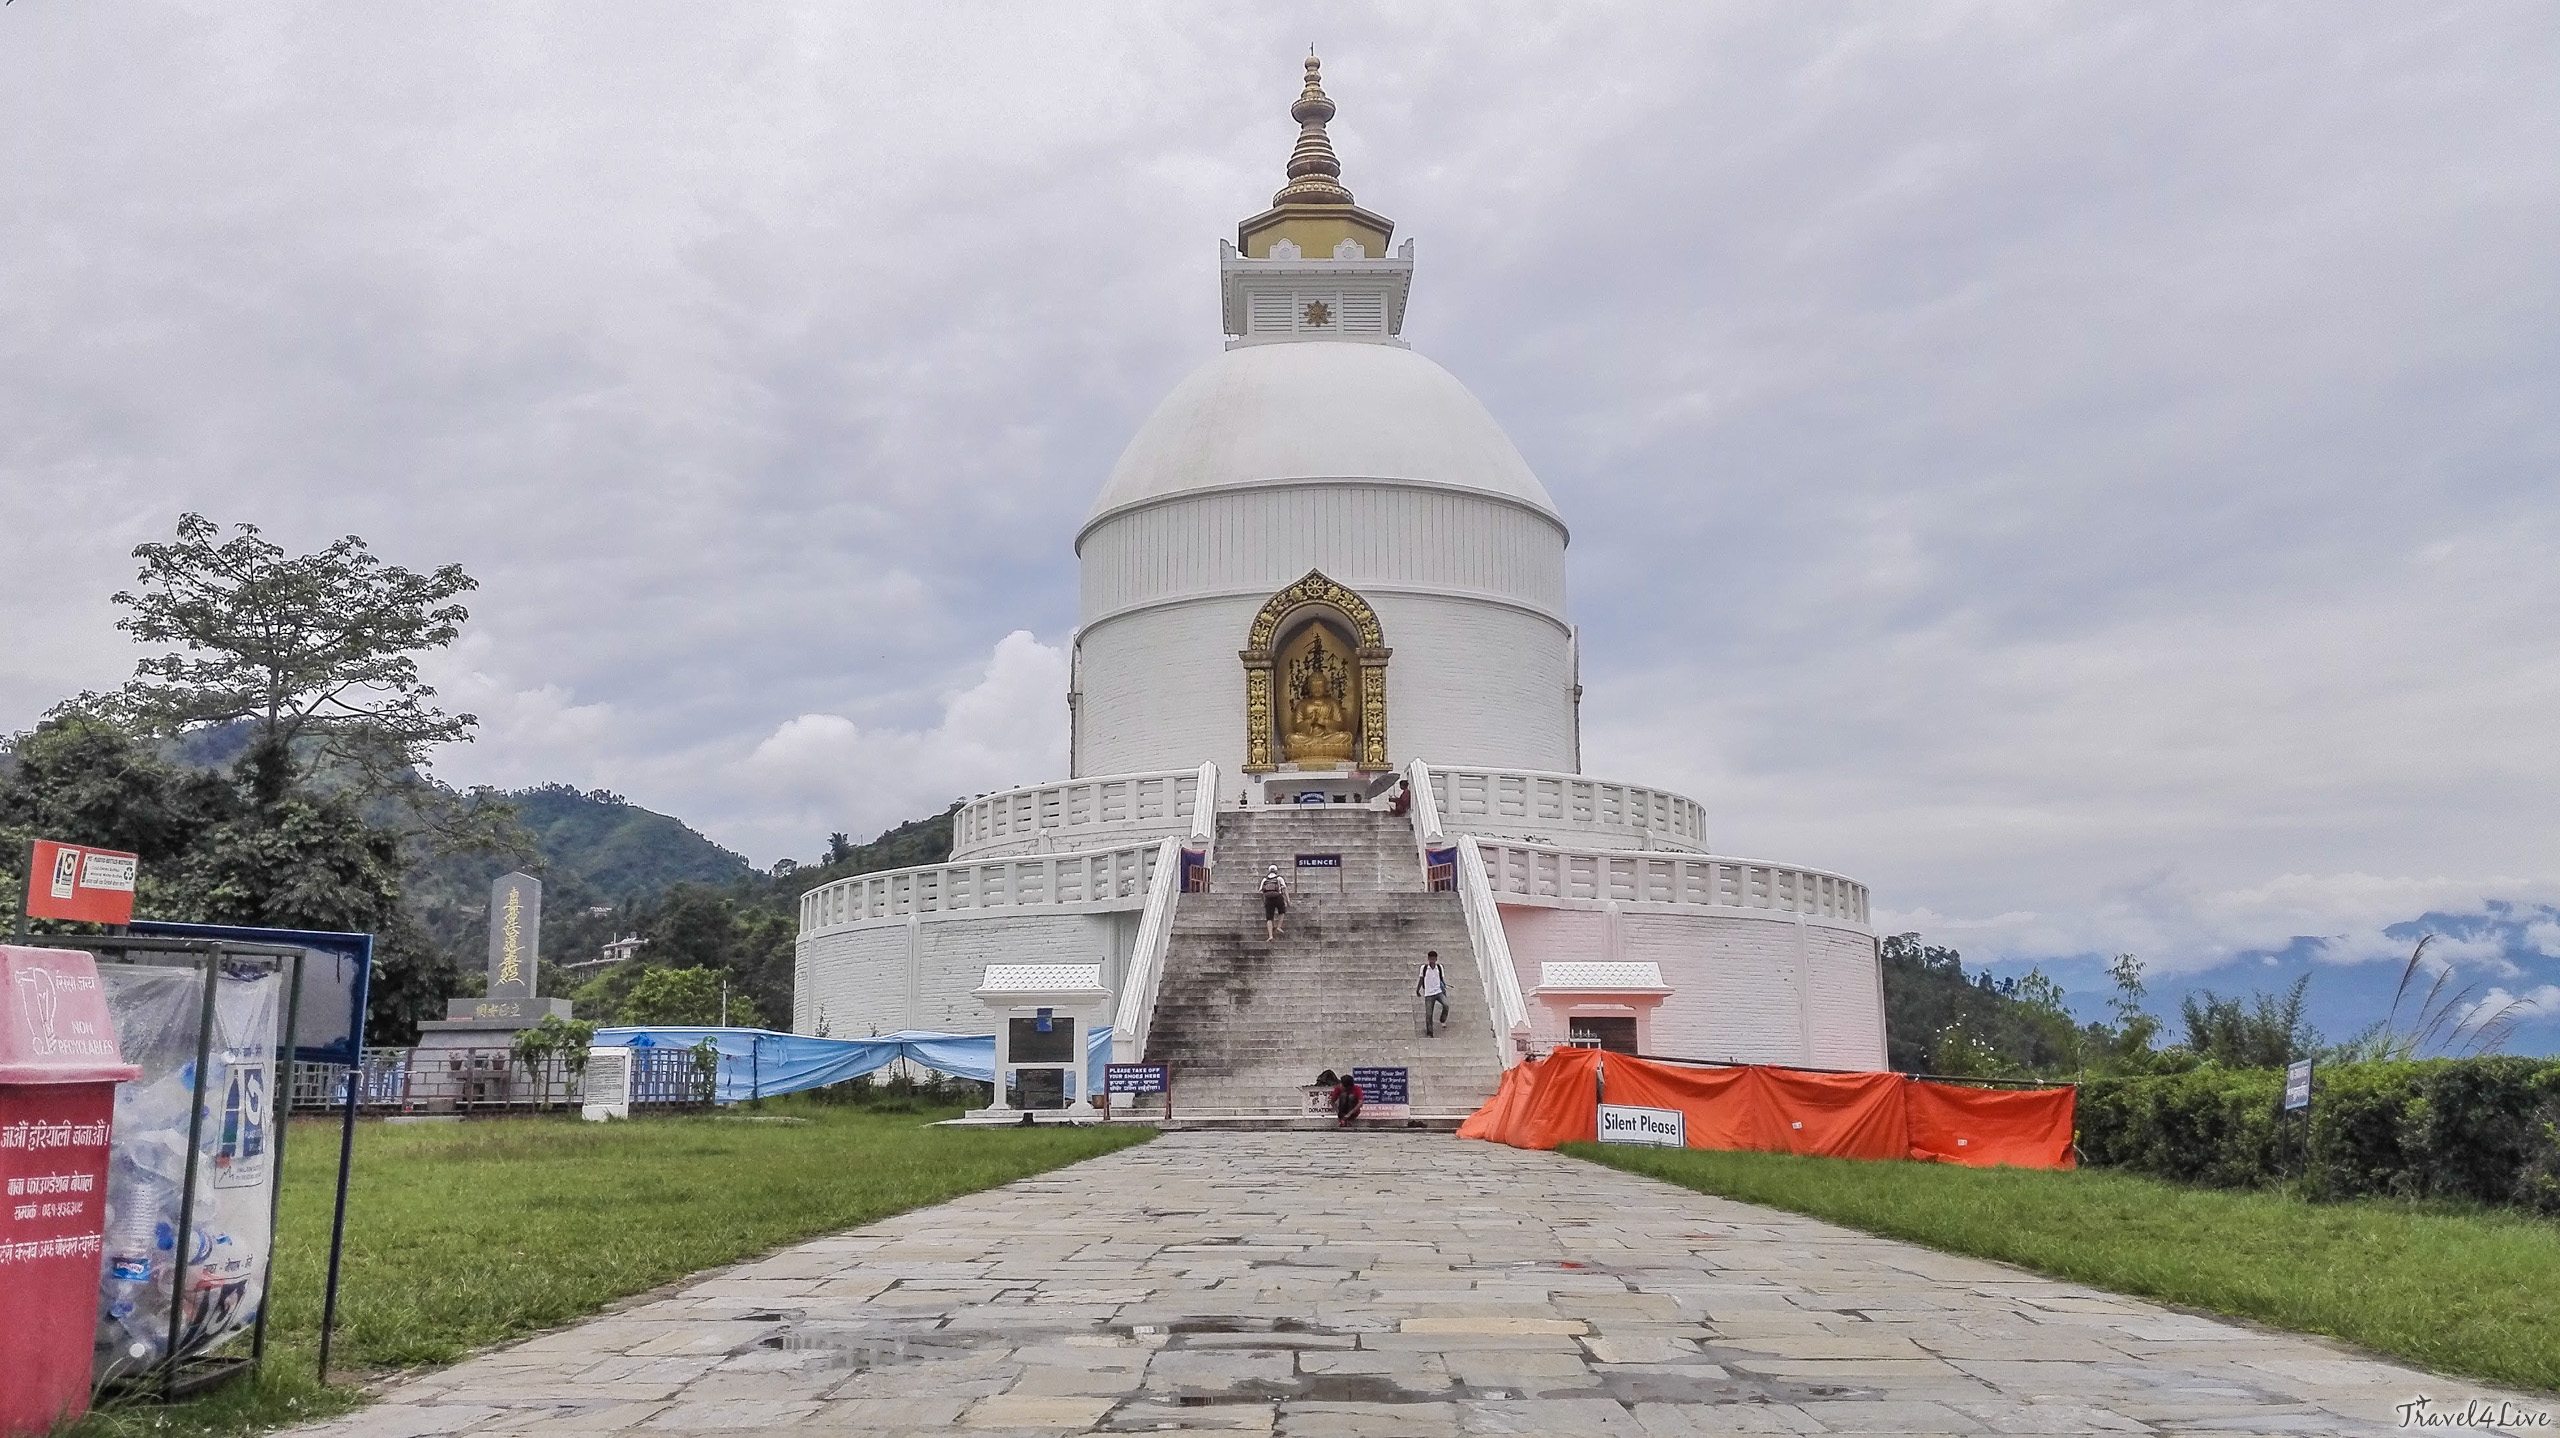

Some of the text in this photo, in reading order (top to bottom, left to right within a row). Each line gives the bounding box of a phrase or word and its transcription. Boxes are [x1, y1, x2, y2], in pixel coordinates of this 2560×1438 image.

[72, 1020, 93, 1035] NON
[58, 1039, 114, 1055] RECYCLABLES
[1604, 1112, 1677, 1135] Silent Please
